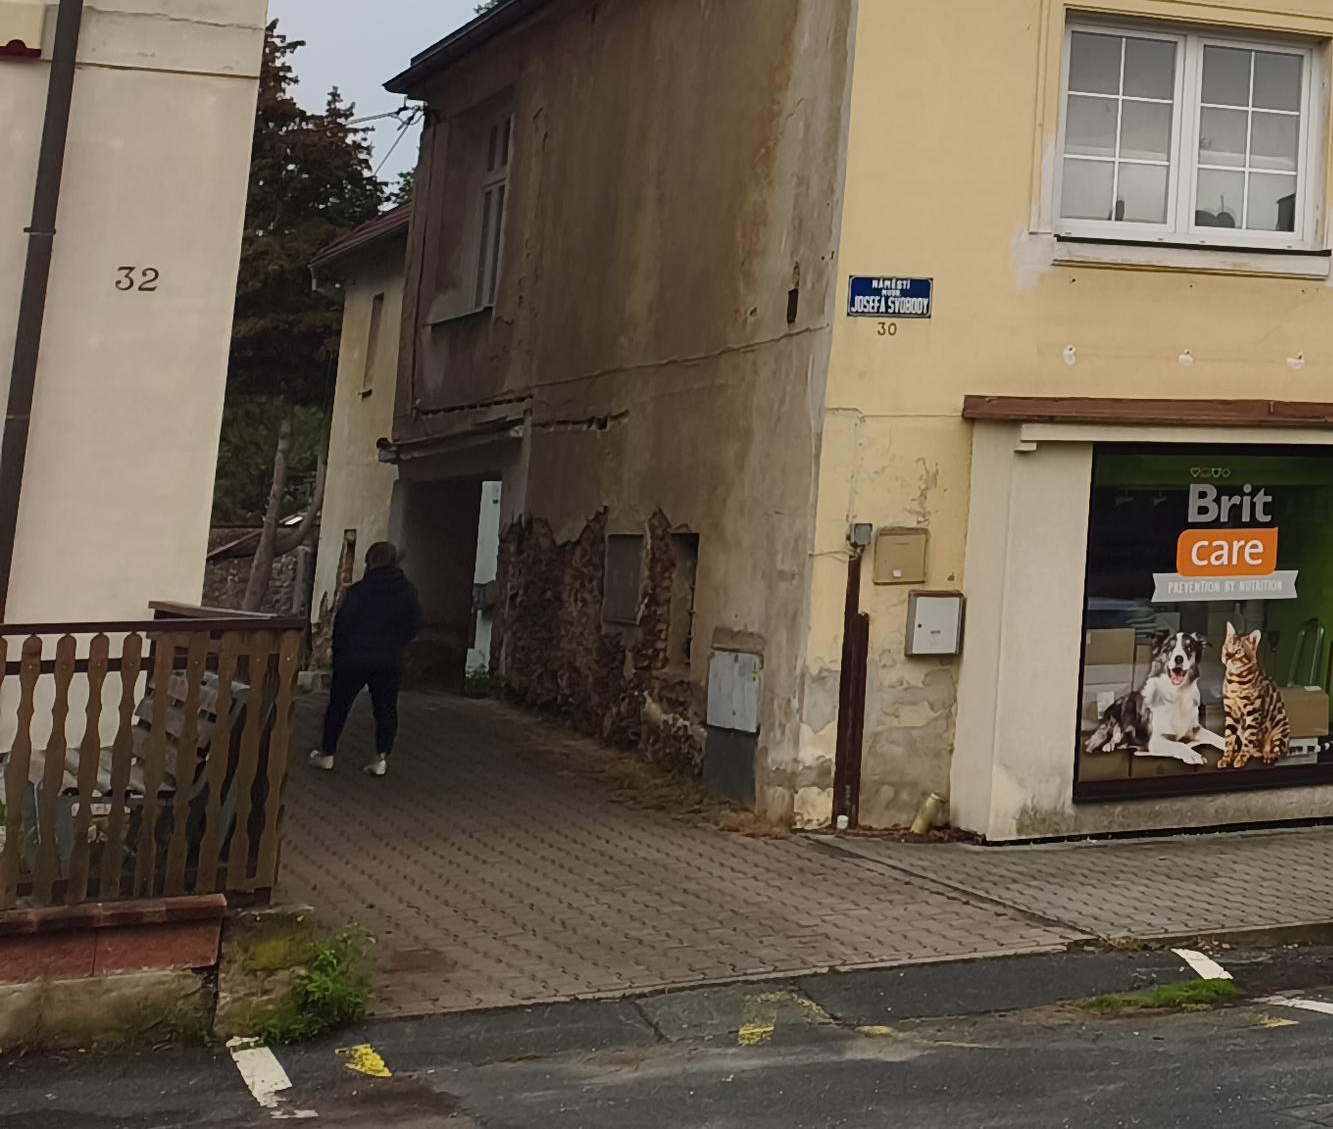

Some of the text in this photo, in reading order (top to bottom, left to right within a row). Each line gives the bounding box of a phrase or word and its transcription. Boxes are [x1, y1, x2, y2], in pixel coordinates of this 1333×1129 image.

[114, 266, 160, 291] 32
[850, 295, 929, 314] JOSEFA SVOBODY
[877, 322, 898, 336] 30
[1188, 483, 1273, 523] Brit
[1191, 539, 1264, 566] care
[1167, 579, 1283, 593] PREVENTION BY NUTRITION
